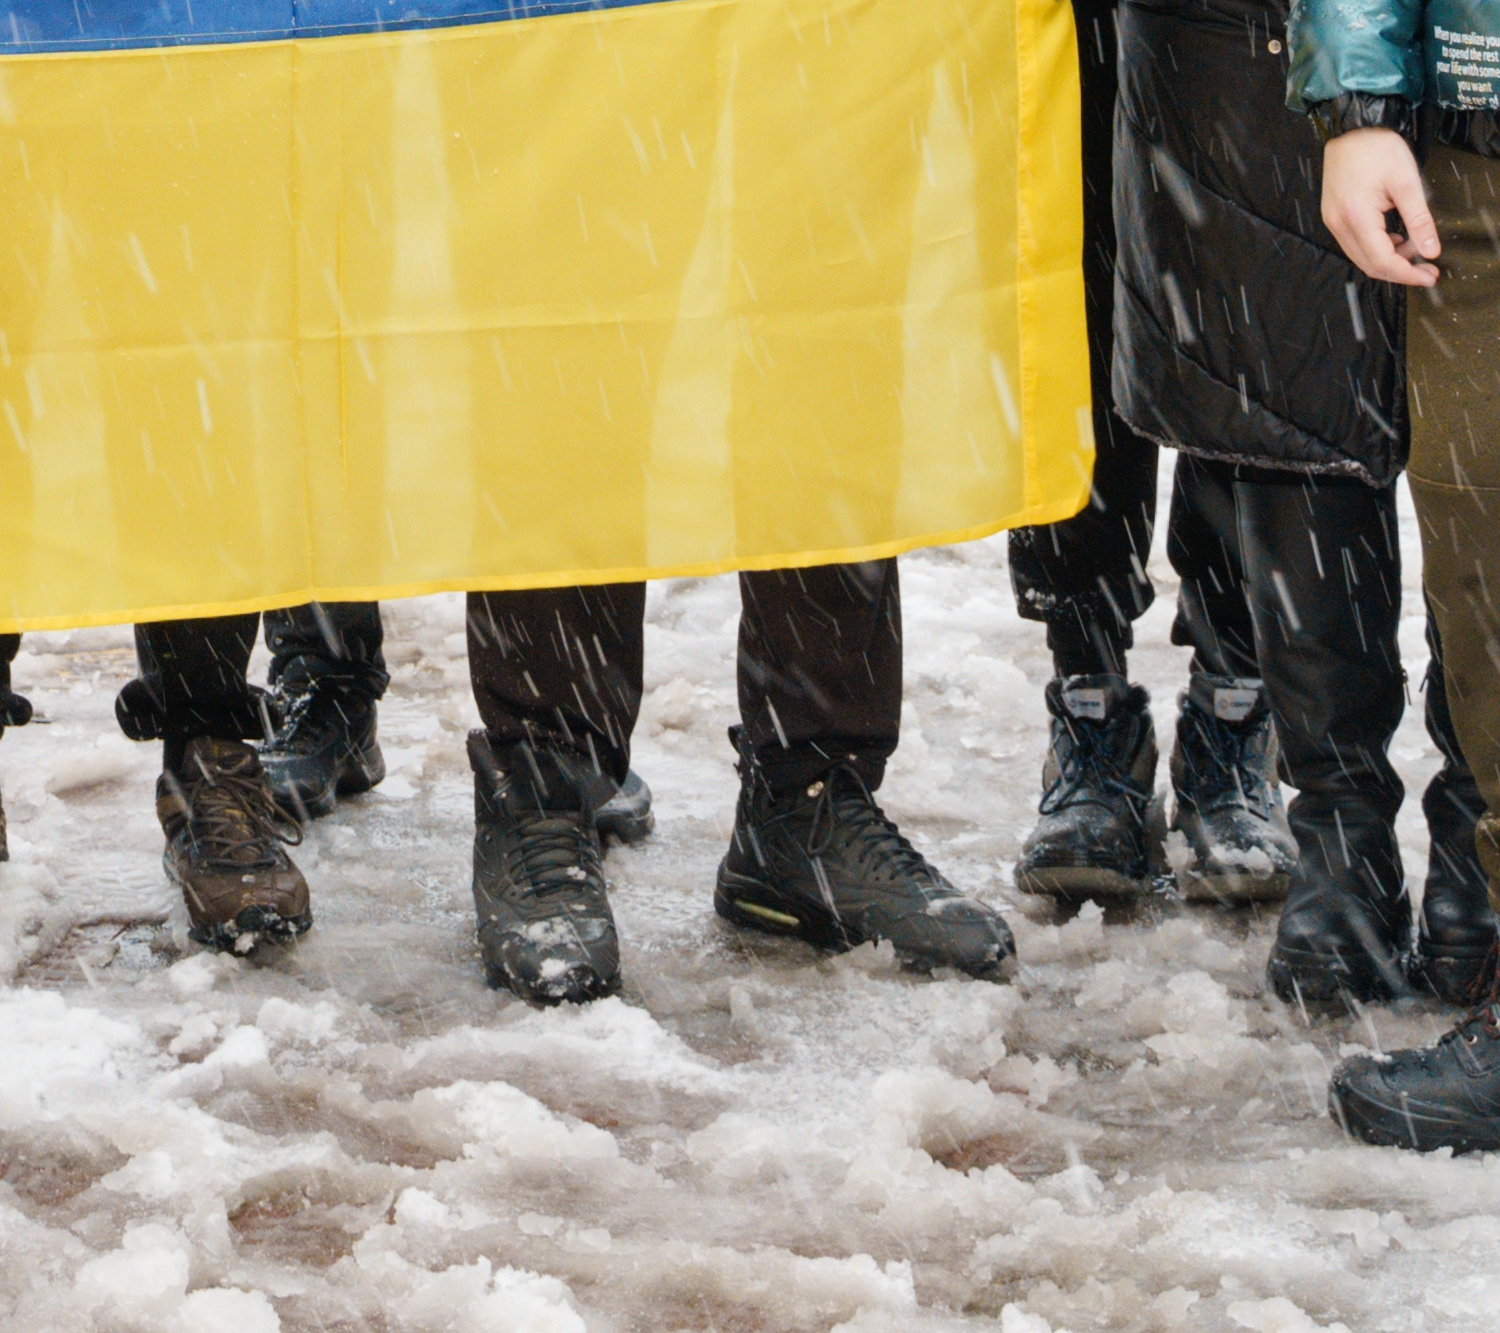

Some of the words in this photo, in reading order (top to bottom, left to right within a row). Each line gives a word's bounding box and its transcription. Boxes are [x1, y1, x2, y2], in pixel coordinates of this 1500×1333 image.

[1449, 32, 1461, 44] you
[1462, 31, 1485, 46] realize
[1486, 36, 1500, 49] you
[1442, 46, 1448, 57] to
[1449, 47, 1469, 60] spend
[1470, 47, 1481, 61] the
[1483, 50, 1499, 62] rest
[1436, 61, 1450, 74] your
[1462, 63, 1479, 76] with
[1457, 81, 1471, 93] you
[1471, 82, 1493, 92] want
